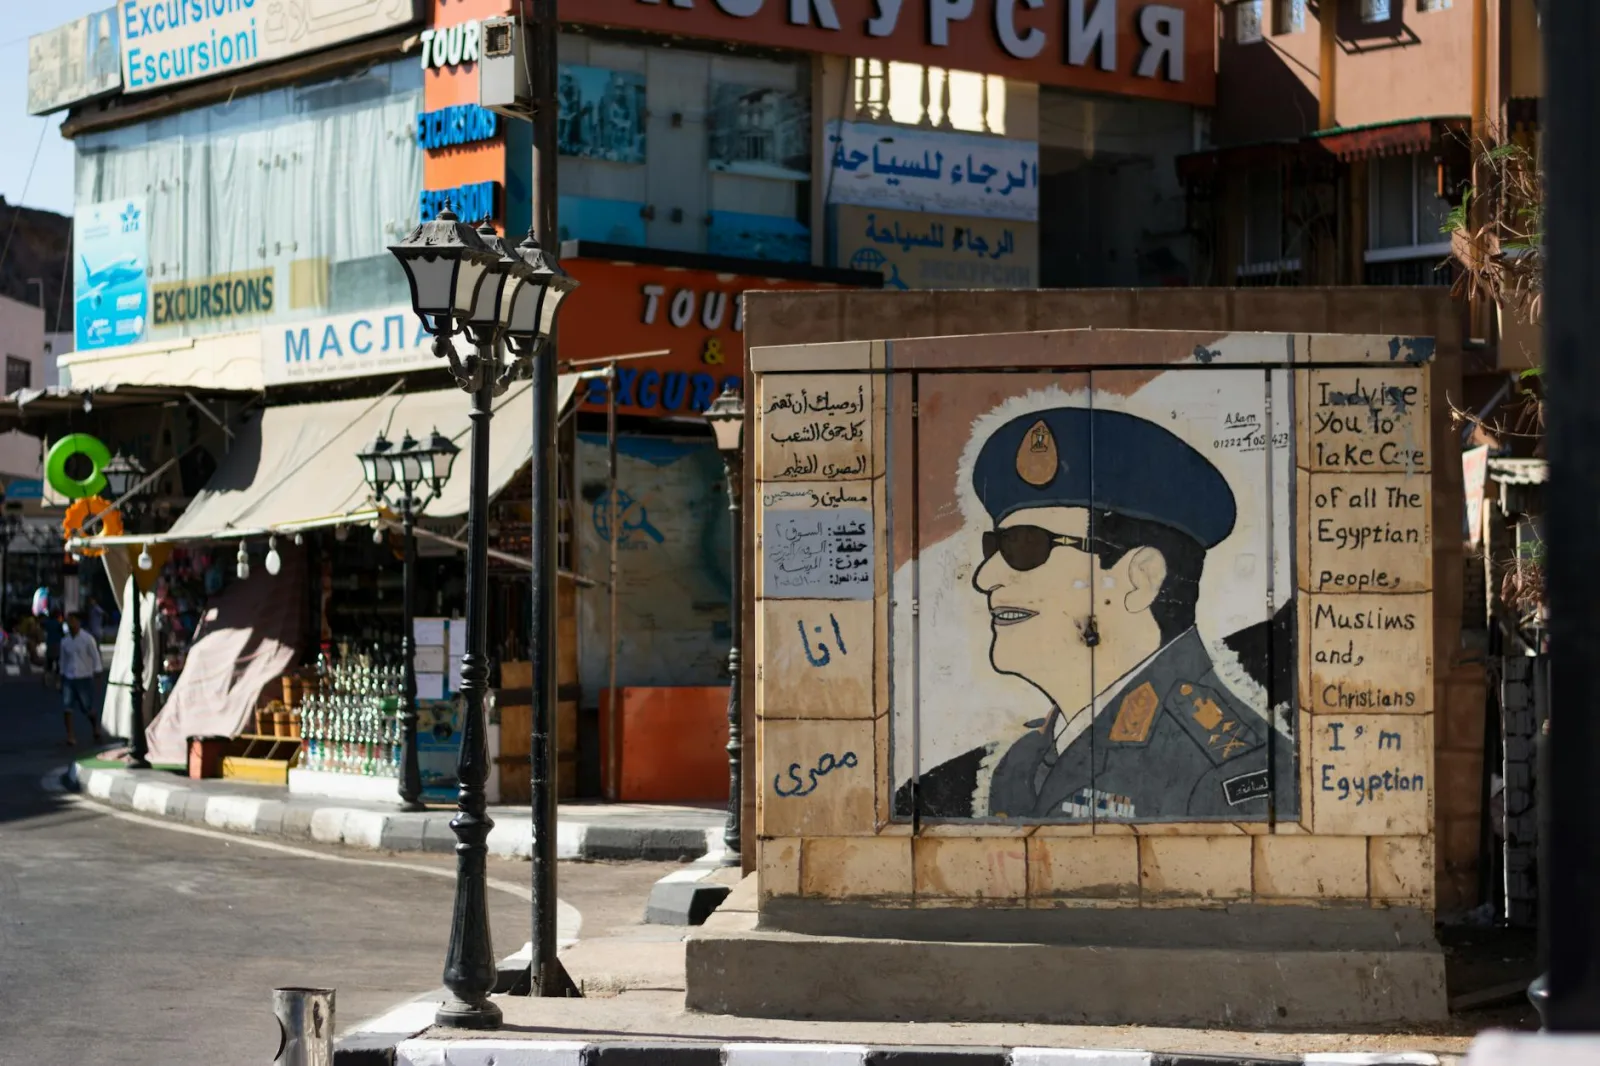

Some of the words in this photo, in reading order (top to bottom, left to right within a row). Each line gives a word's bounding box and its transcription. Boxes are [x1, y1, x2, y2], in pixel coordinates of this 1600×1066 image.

[124, 0, 255, 39] Excurso
[128, 17, 258, 87] Escursioni
[420, 17, 480, 70] TOUR
[417, 103, 497, 150] EXCURSIONS
[829, 134, 944, 187] للسياحة
[951, 153, 1038, 196] الرجاء
[865, 213, 944, 252] للسياحة
[153, 275, 274, 326] EXCURSIONS
[704, 338, 725, 365] &
[1349, 487, 1376, 509] all
[1385, 487, 1423, 509] The
[1318, 518, 1419, 550] Egyptian
[1314, 604, 1415, 630] Muslims
[1322, 684, 1416, 709] Christians
[1321, 764, 1424, 806] Egyptian
